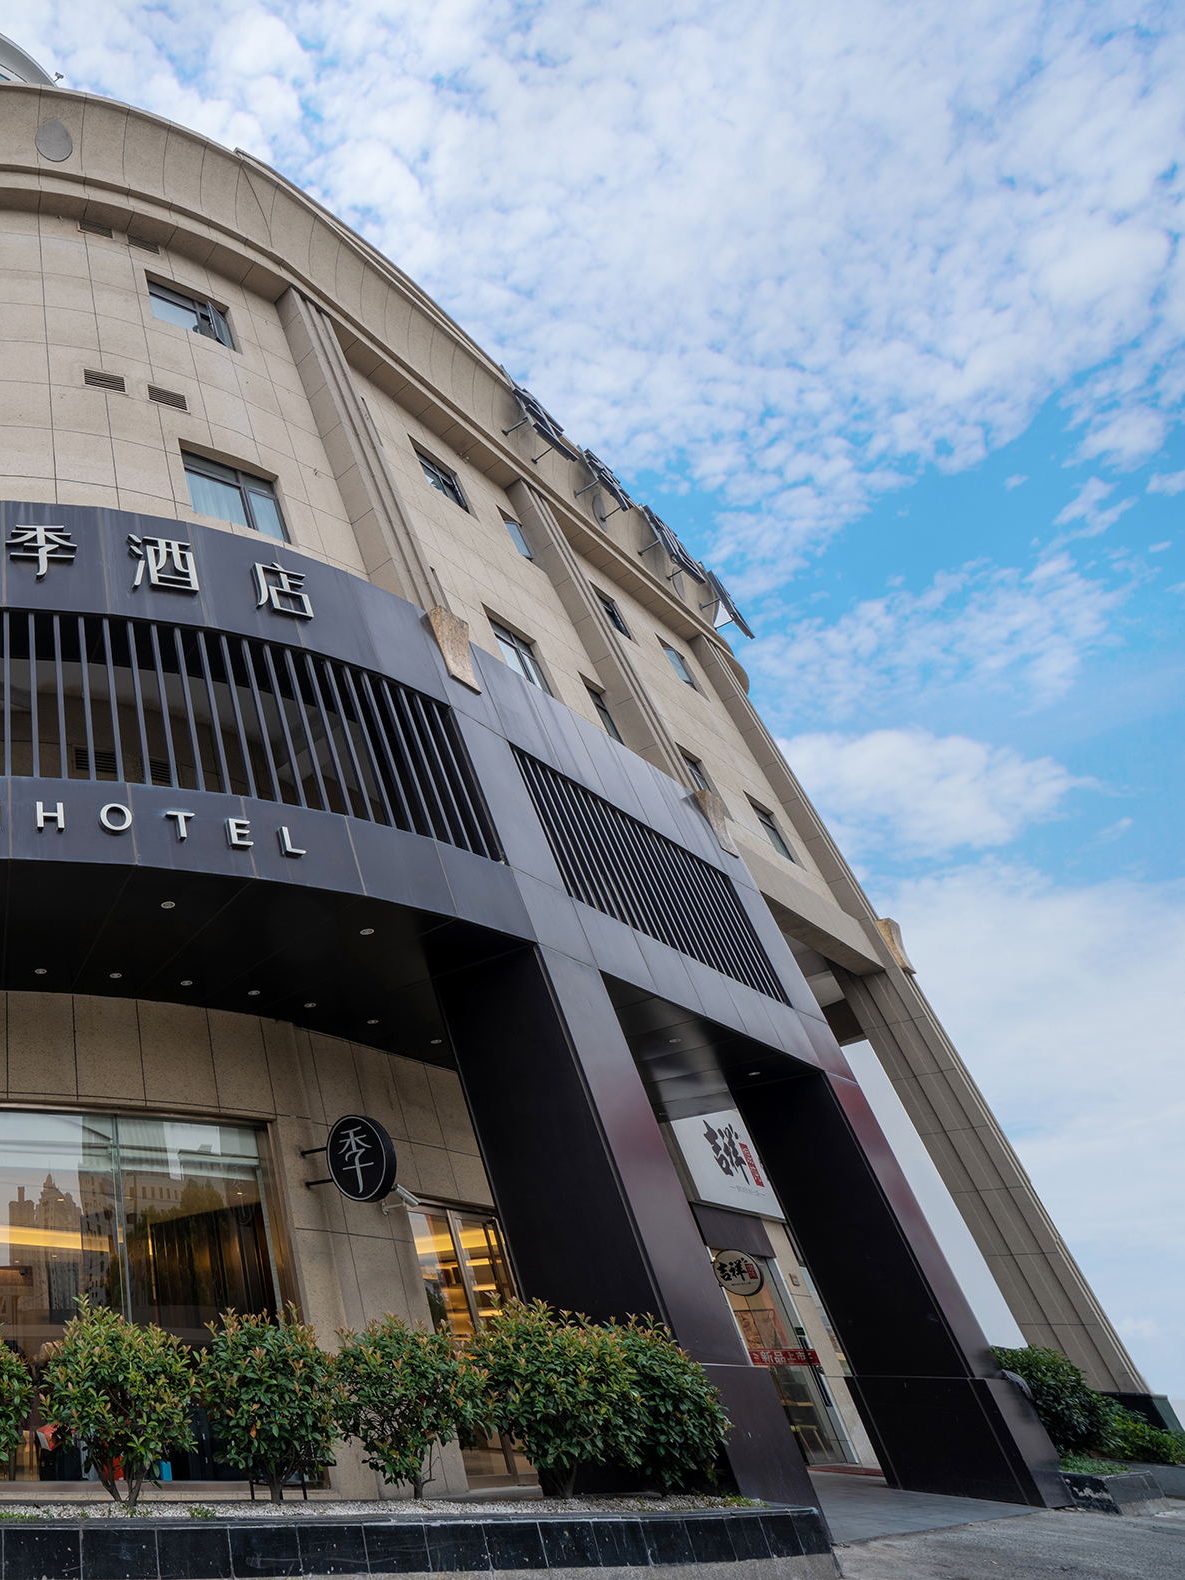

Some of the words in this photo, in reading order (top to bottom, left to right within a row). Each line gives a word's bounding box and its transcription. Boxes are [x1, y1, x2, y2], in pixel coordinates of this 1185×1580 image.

[338, 1126, 374, 1194] 季
[702, 1119, 750, 1186] 吉祥
[716, 1257, 748, 1281] 吉祥
[760, 1351, 806, 1364] 新品上市
